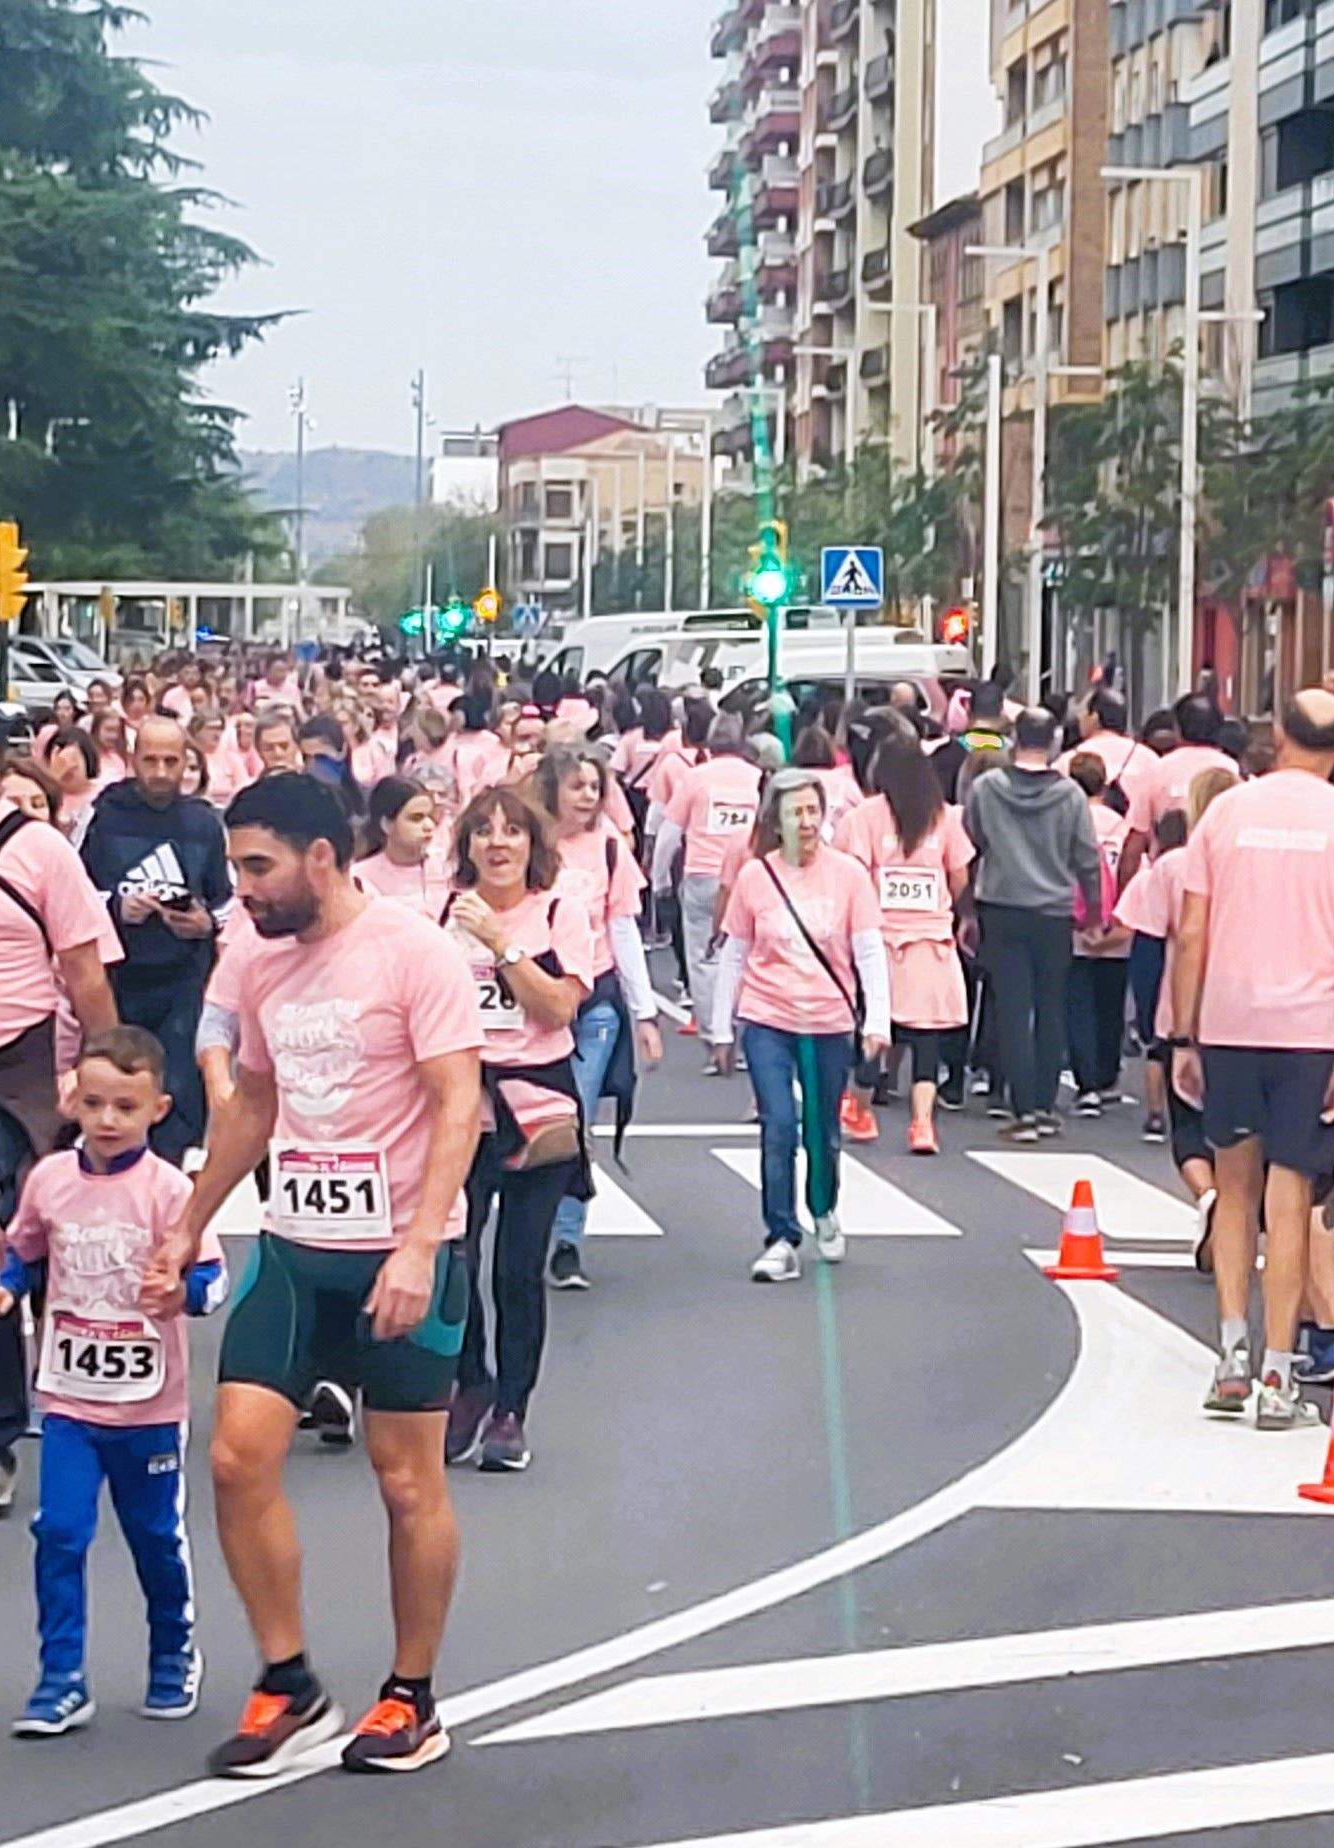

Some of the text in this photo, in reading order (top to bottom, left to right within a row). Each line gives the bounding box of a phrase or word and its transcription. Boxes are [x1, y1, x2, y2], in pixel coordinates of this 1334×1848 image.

[888, 881, 933, 899] 2051
[283, 1178, 376, 1214] 1451
[58, 1338, 154, 1379] 1453
